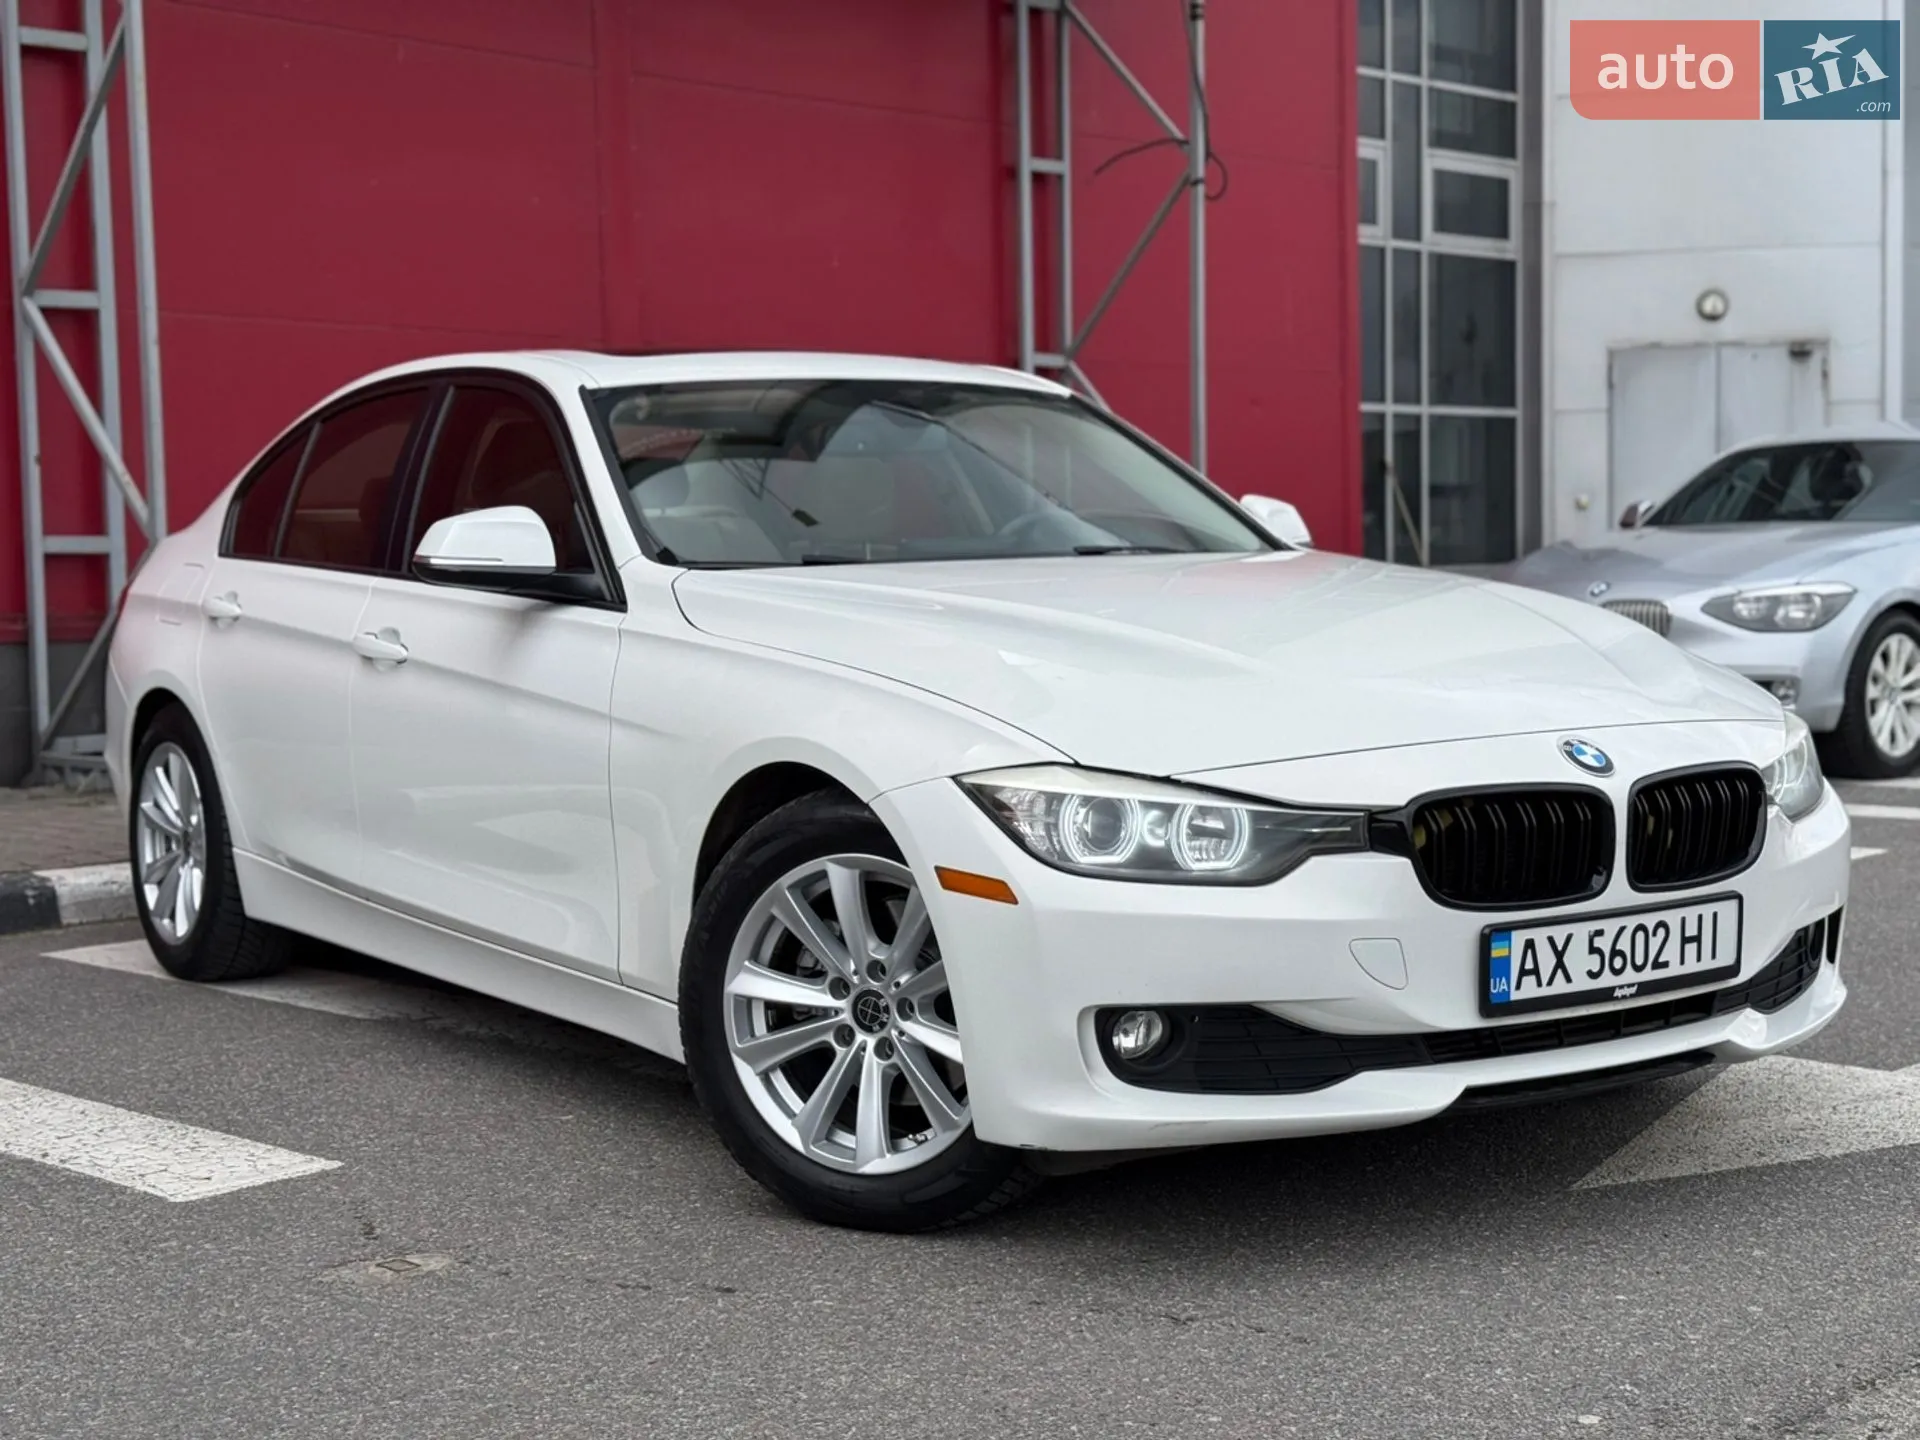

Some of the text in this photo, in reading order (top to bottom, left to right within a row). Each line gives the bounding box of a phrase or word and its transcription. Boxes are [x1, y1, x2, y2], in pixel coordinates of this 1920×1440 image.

[1514, 911, 1718, 991] AX 5602 HI
[1490, 977, 1509, 994] UA
